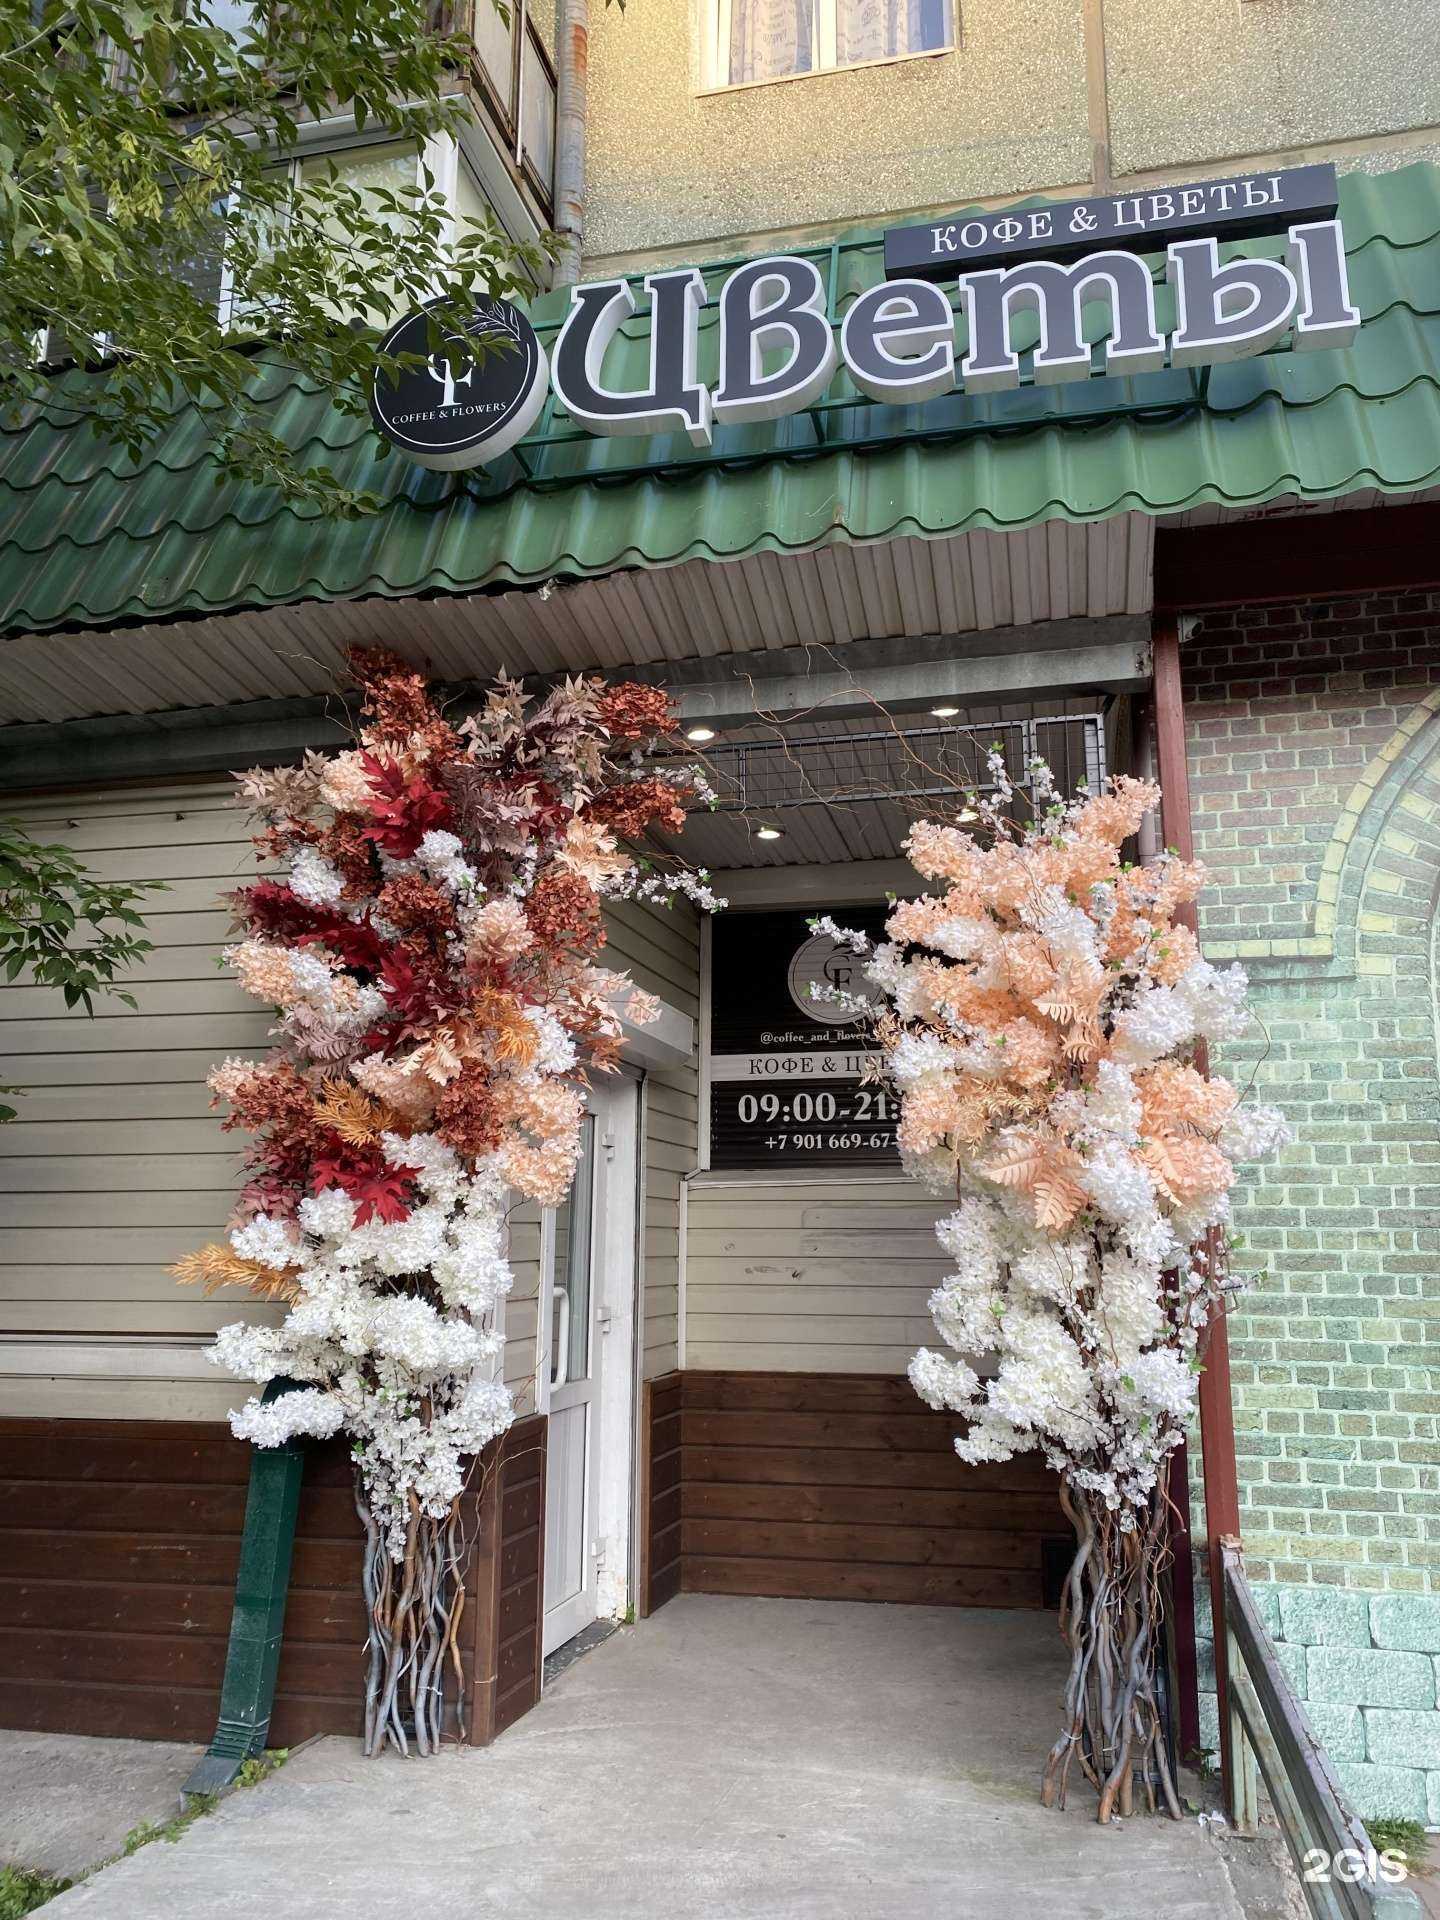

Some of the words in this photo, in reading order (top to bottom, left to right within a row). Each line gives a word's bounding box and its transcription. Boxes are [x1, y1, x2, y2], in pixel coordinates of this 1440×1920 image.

[930, 211, 1053, 254] КОФЕ
[1069, 205, 1098, 233] &
[1113, 175, 1284, 229] ЦВЕТЫ
[392, 411, 436, 425] COFFEE
[438, 409, 449, 419] &
[452, 402, 507, 417] FLOWERS
[749, 1057, 814, 1075] КОФЕ
[821, 1057, 837, 1073] &
[765, 1135, 787, 1149] +7
[793, 1134, 823, 1149] 901
